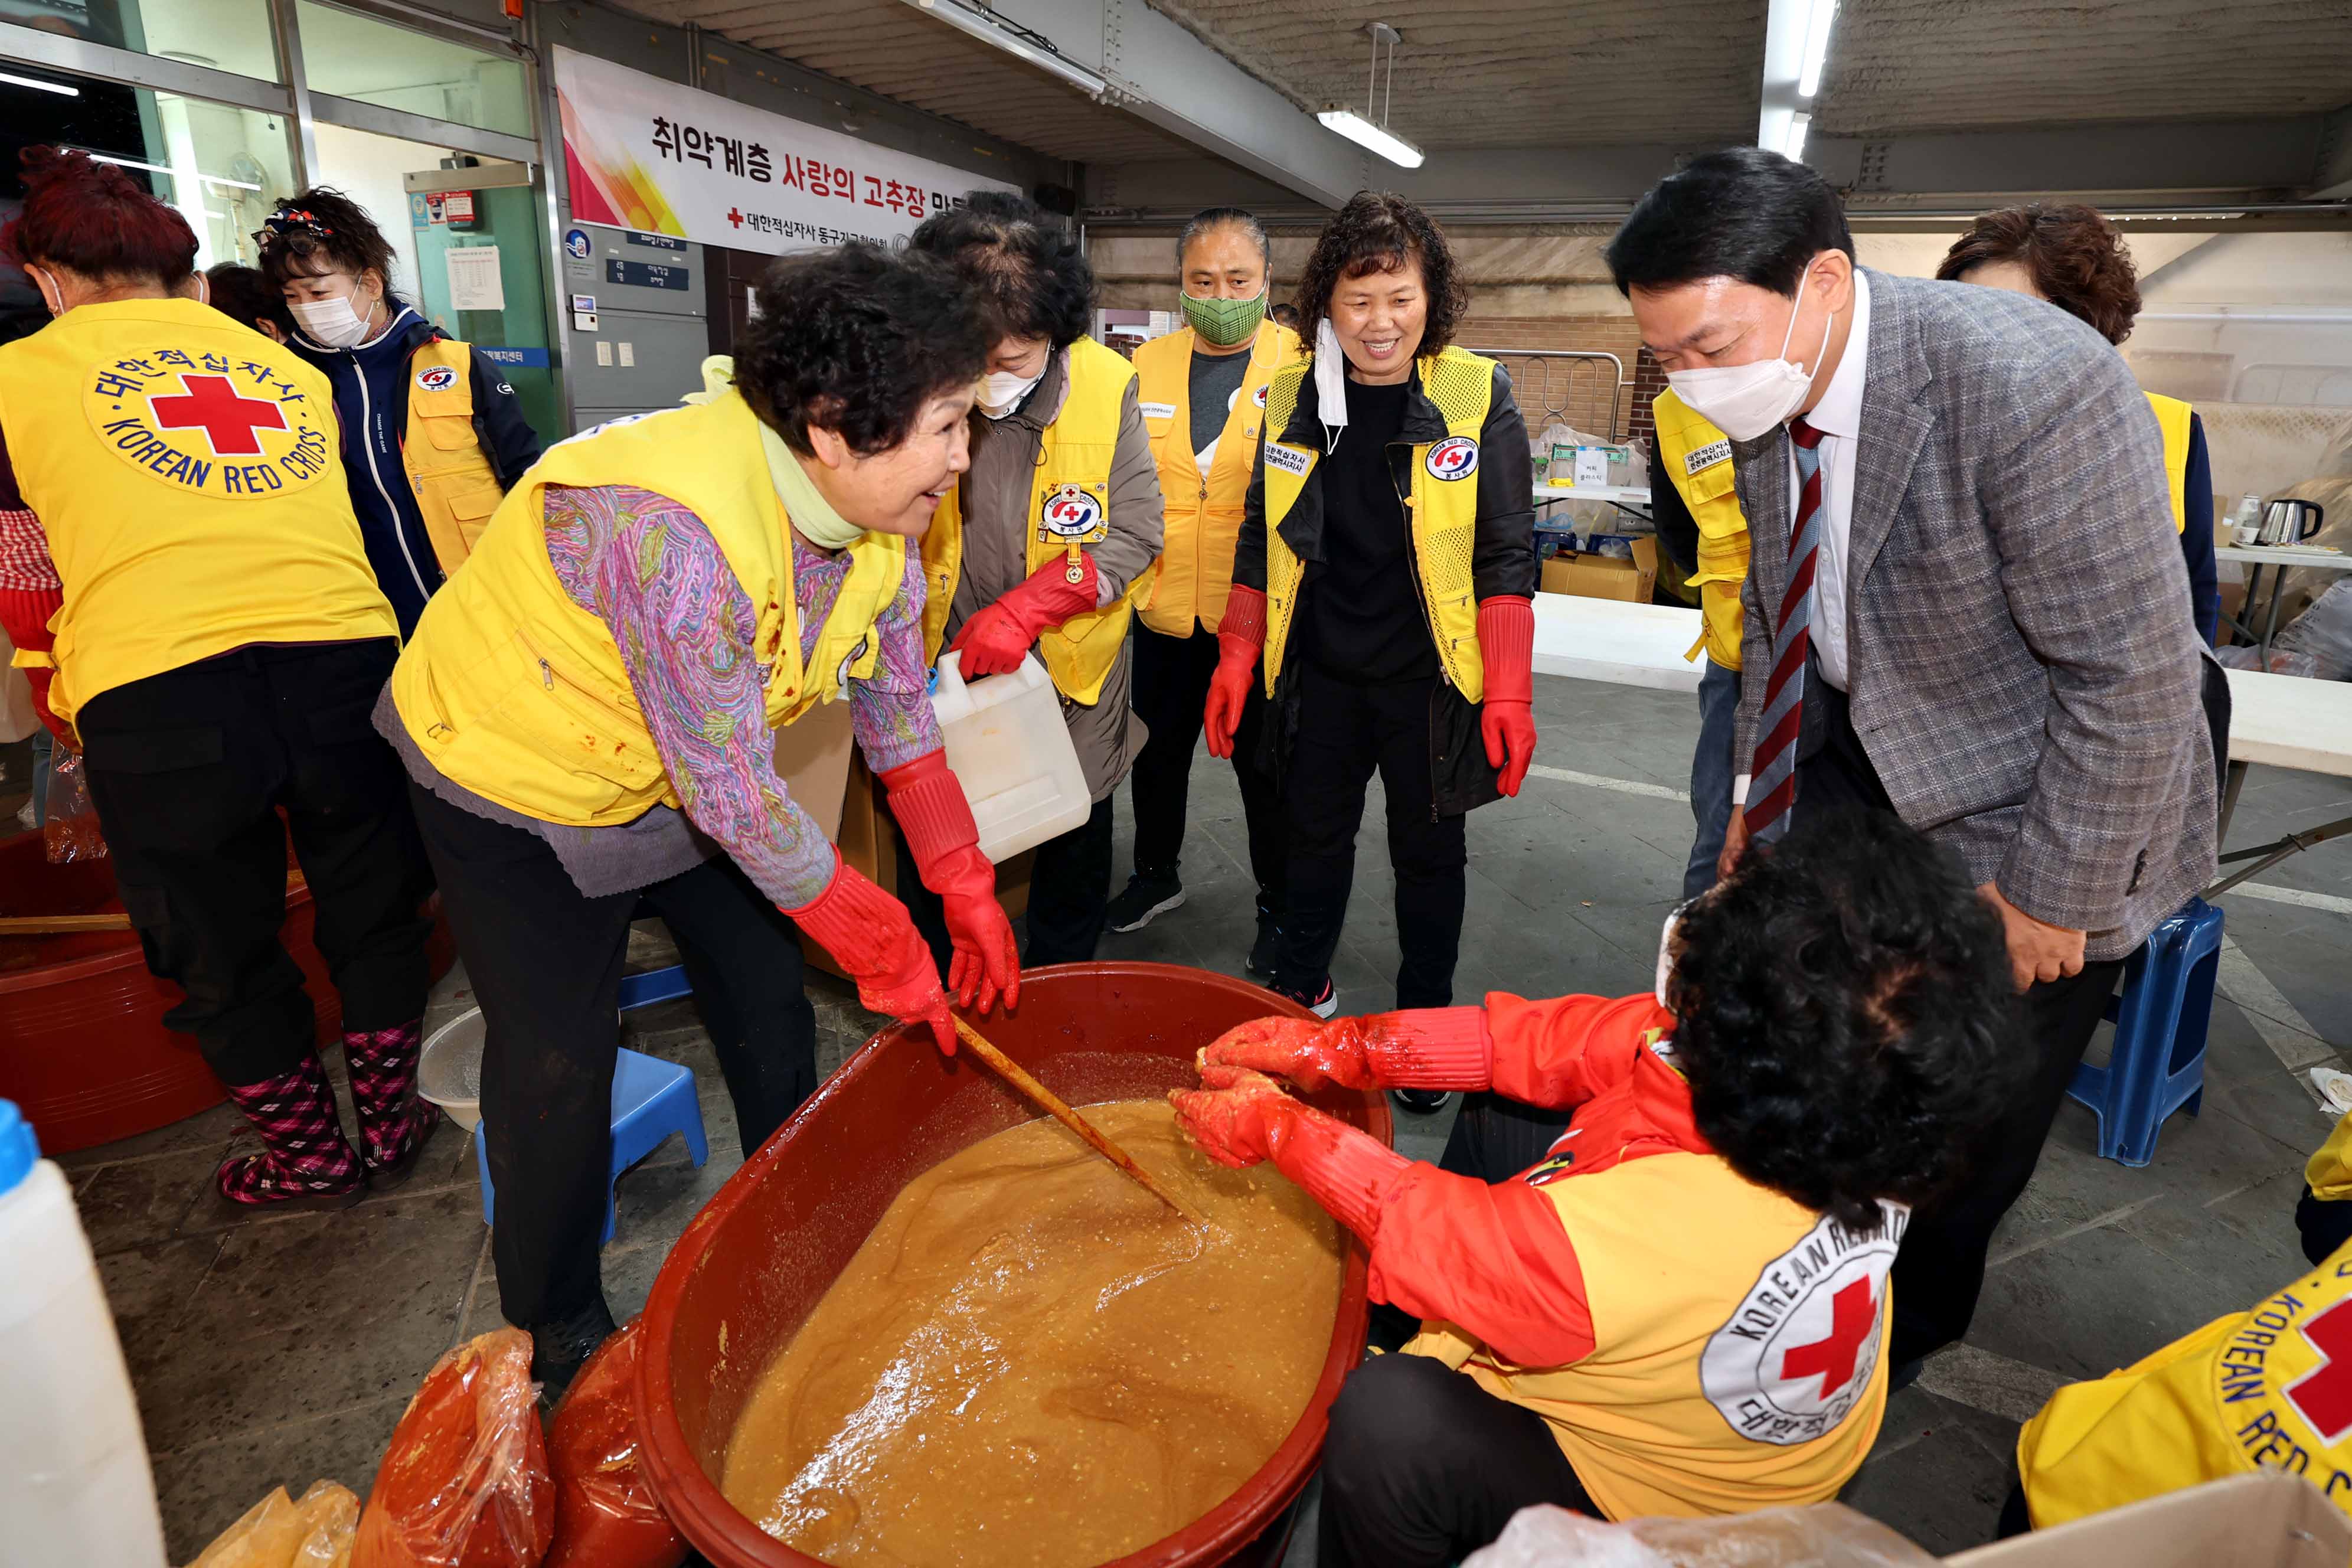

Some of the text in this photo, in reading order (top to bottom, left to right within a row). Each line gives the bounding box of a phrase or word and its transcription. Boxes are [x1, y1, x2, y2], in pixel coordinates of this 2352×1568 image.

[652, 117, 772, 183] 취약계층
[782, 153, 856, 203] 사랑의
[864, 175, 926, 218] 고추장
[747, 213, 816, 241] 대한적십자사
[94, 349, 306, 403] 대한적십자사
[102, 418, 326, 494] KOREAN RED CROSS
[1430, 443, 1446, 459] KOREAN
[1460, 439, 1476, 450] CROSS
[1048, 497, 1061, 509] KORE
[1729, 1238, 1830, 1342] KOREAN
[2221, 1293, 2309, 1475] KOREAN RED
